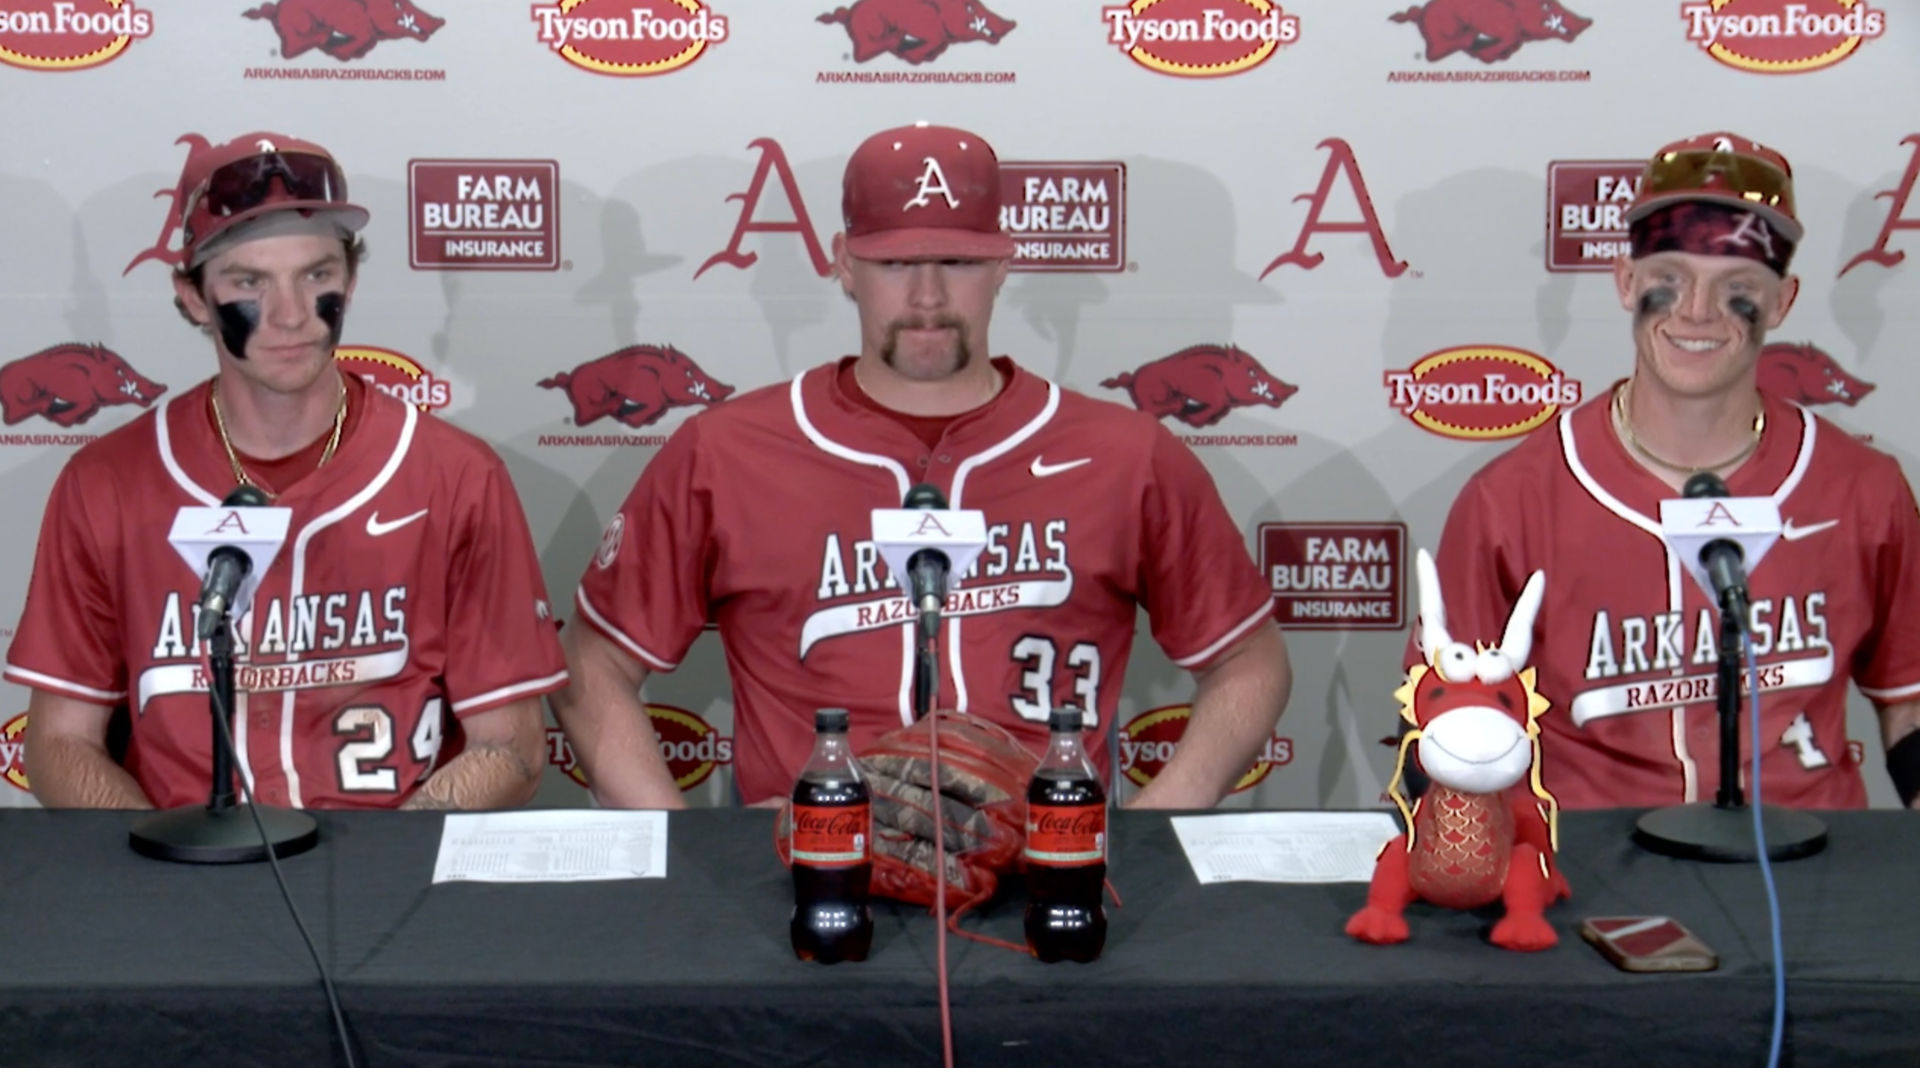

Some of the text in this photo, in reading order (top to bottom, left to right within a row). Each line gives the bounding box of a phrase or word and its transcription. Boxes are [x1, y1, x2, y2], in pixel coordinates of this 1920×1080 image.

[53, 2, 150, 35] Foods
[535, 8, 725, 49] Tyson Foods
[1106, 9, 1296, 51] Tyson Foods
[1685, 4, 1882, 47] Tyson Foods
[243, 67, 446, 81] ARKANSASRAZORBACKS.COM
[815, 71, 1016, 84] ARKANSASRAZORBACKS.COM
[1387, 70, 1591, 83] ARKANSASRAZORBACKS.COM
[458, 174, 542, 201] FARM
[903, 156, 960, 212] A
[1025, 176, 1108, 203] FARM
[423, 202, 544, 229] BUREAU
[693, 136, 838, 281] A
[1258, 137, 1409, 283] A
[445, 239, 545, 257] INSURANCE
[1388, 371, 1579, 414] Tyson Foods
[203, 509, 251, 535] A
[907, 511, 954, 538] A
[1695, 500, 1744, 528] A
[817, 519, 1067, 600] ARSAS
[1306, 537, 1390, 563] FARM
[1272, 564, 1391, 590] BUREAU
[856, 585, 1020, 628] RAZOBACKS
[1292, 600, 1391, 618] INSURANCE
[1584, 591, 1828, 680] ARKASAS
[191, 660, 356, 689] RORBACKS
[1010, 634, 1101, 729] 33
[334, 695, 443, 792] 24
[653, 731, 732, 762] oods
